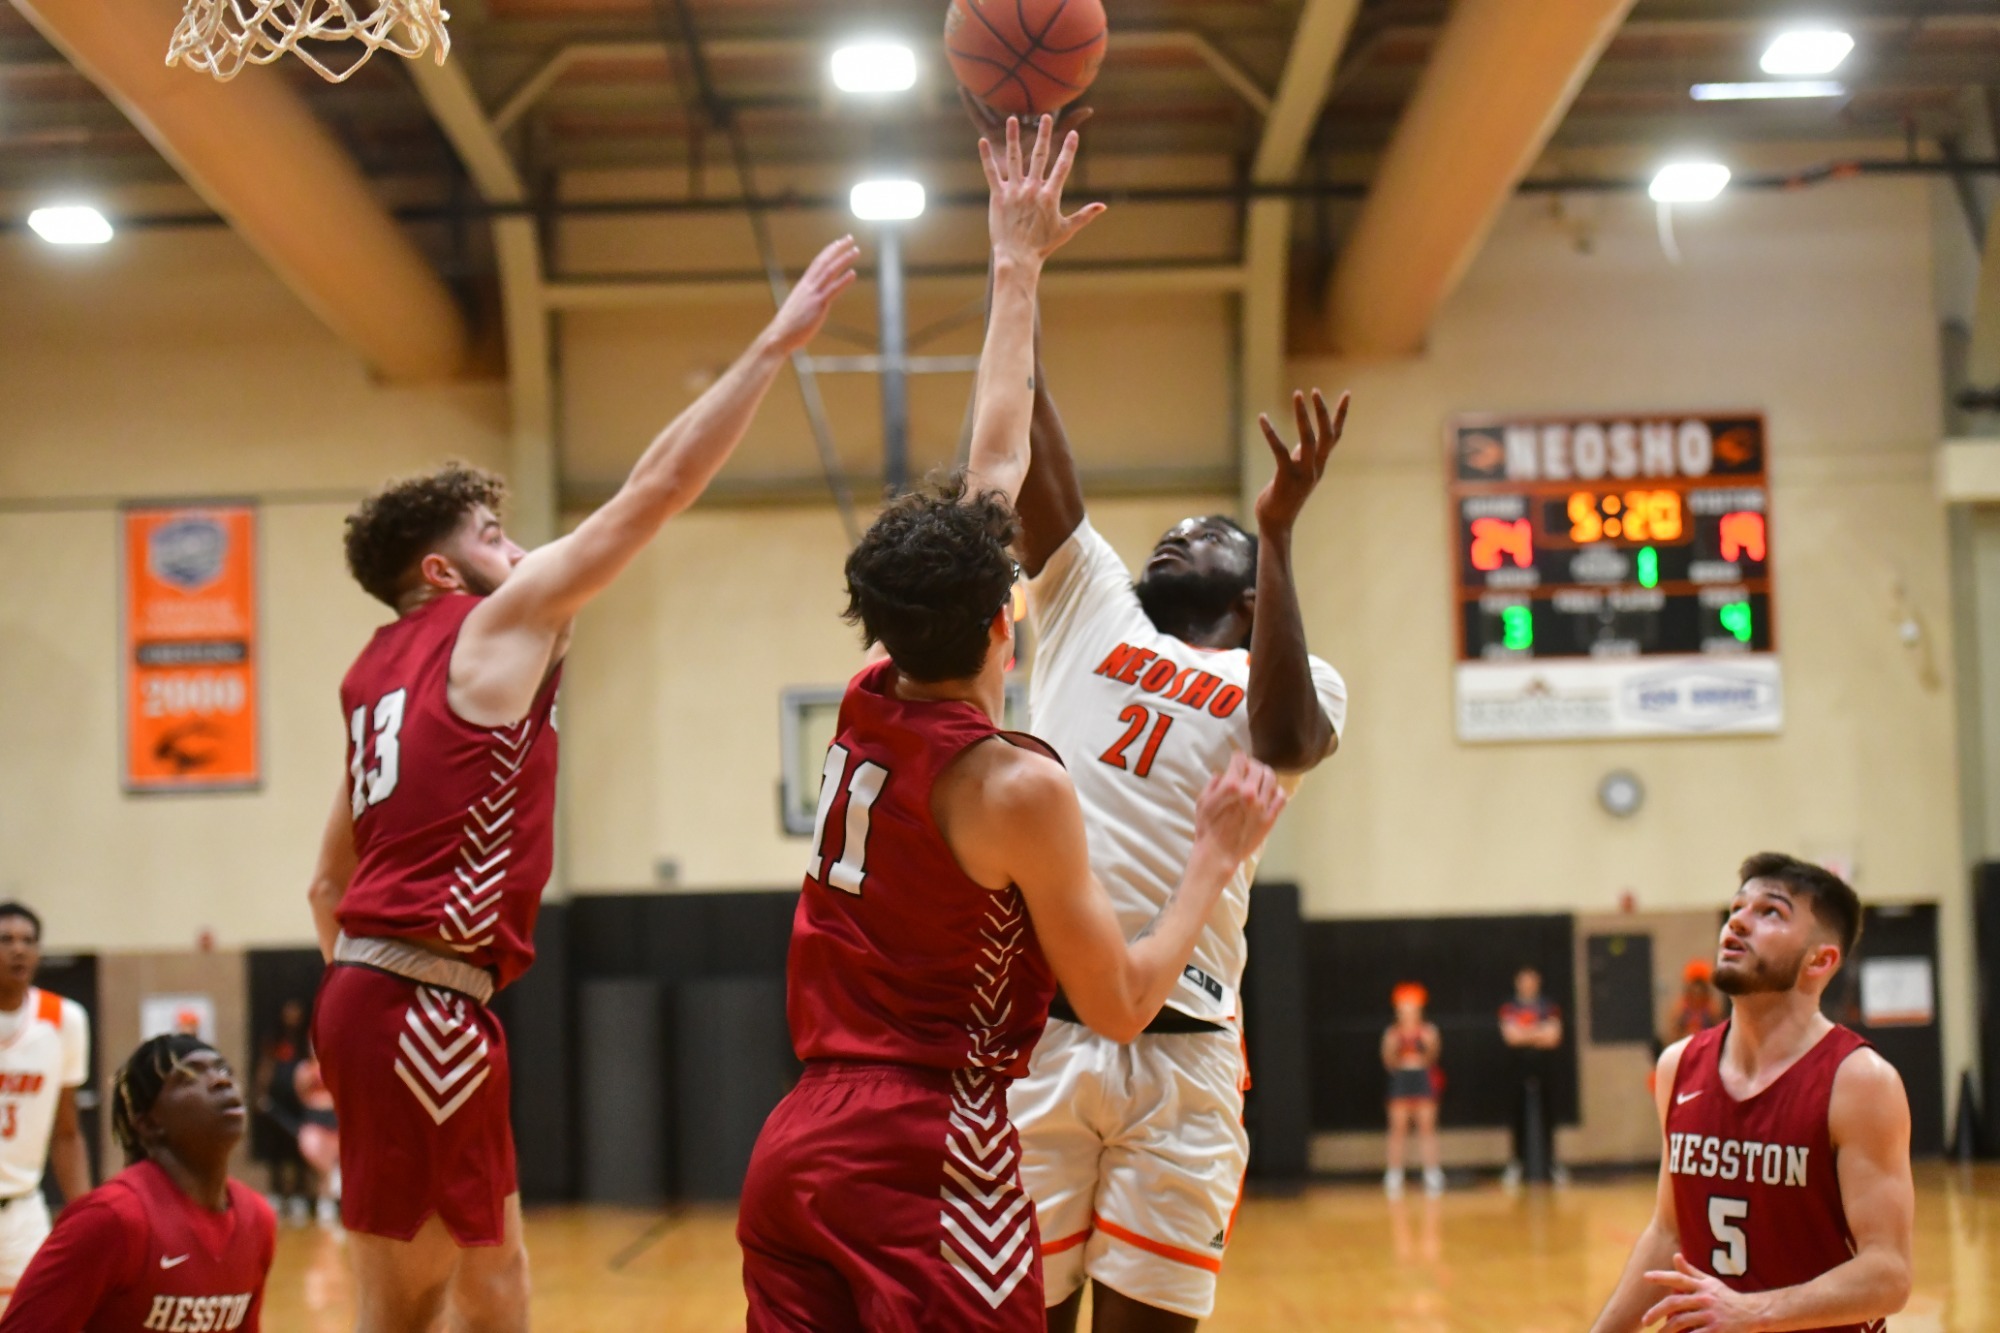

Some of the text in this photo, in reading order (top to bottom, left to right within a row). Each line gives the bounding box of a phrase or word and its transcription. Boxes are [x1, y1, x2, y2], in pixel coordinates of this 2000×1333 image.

[1505, 419, 1713, 480] NEOSHO
[1093, 642, 1244, 719] NEOSHO
[350, 686, 408, 822] 13
[1098, 704, 1174, 778] 21
[806, 742, 890, 898] 11
[1668, 1132, 1810, 1188] HESSTON
[1708, 1195, 1748, 1277] 5
[143, 1292, 253, 1333] HESSTO
